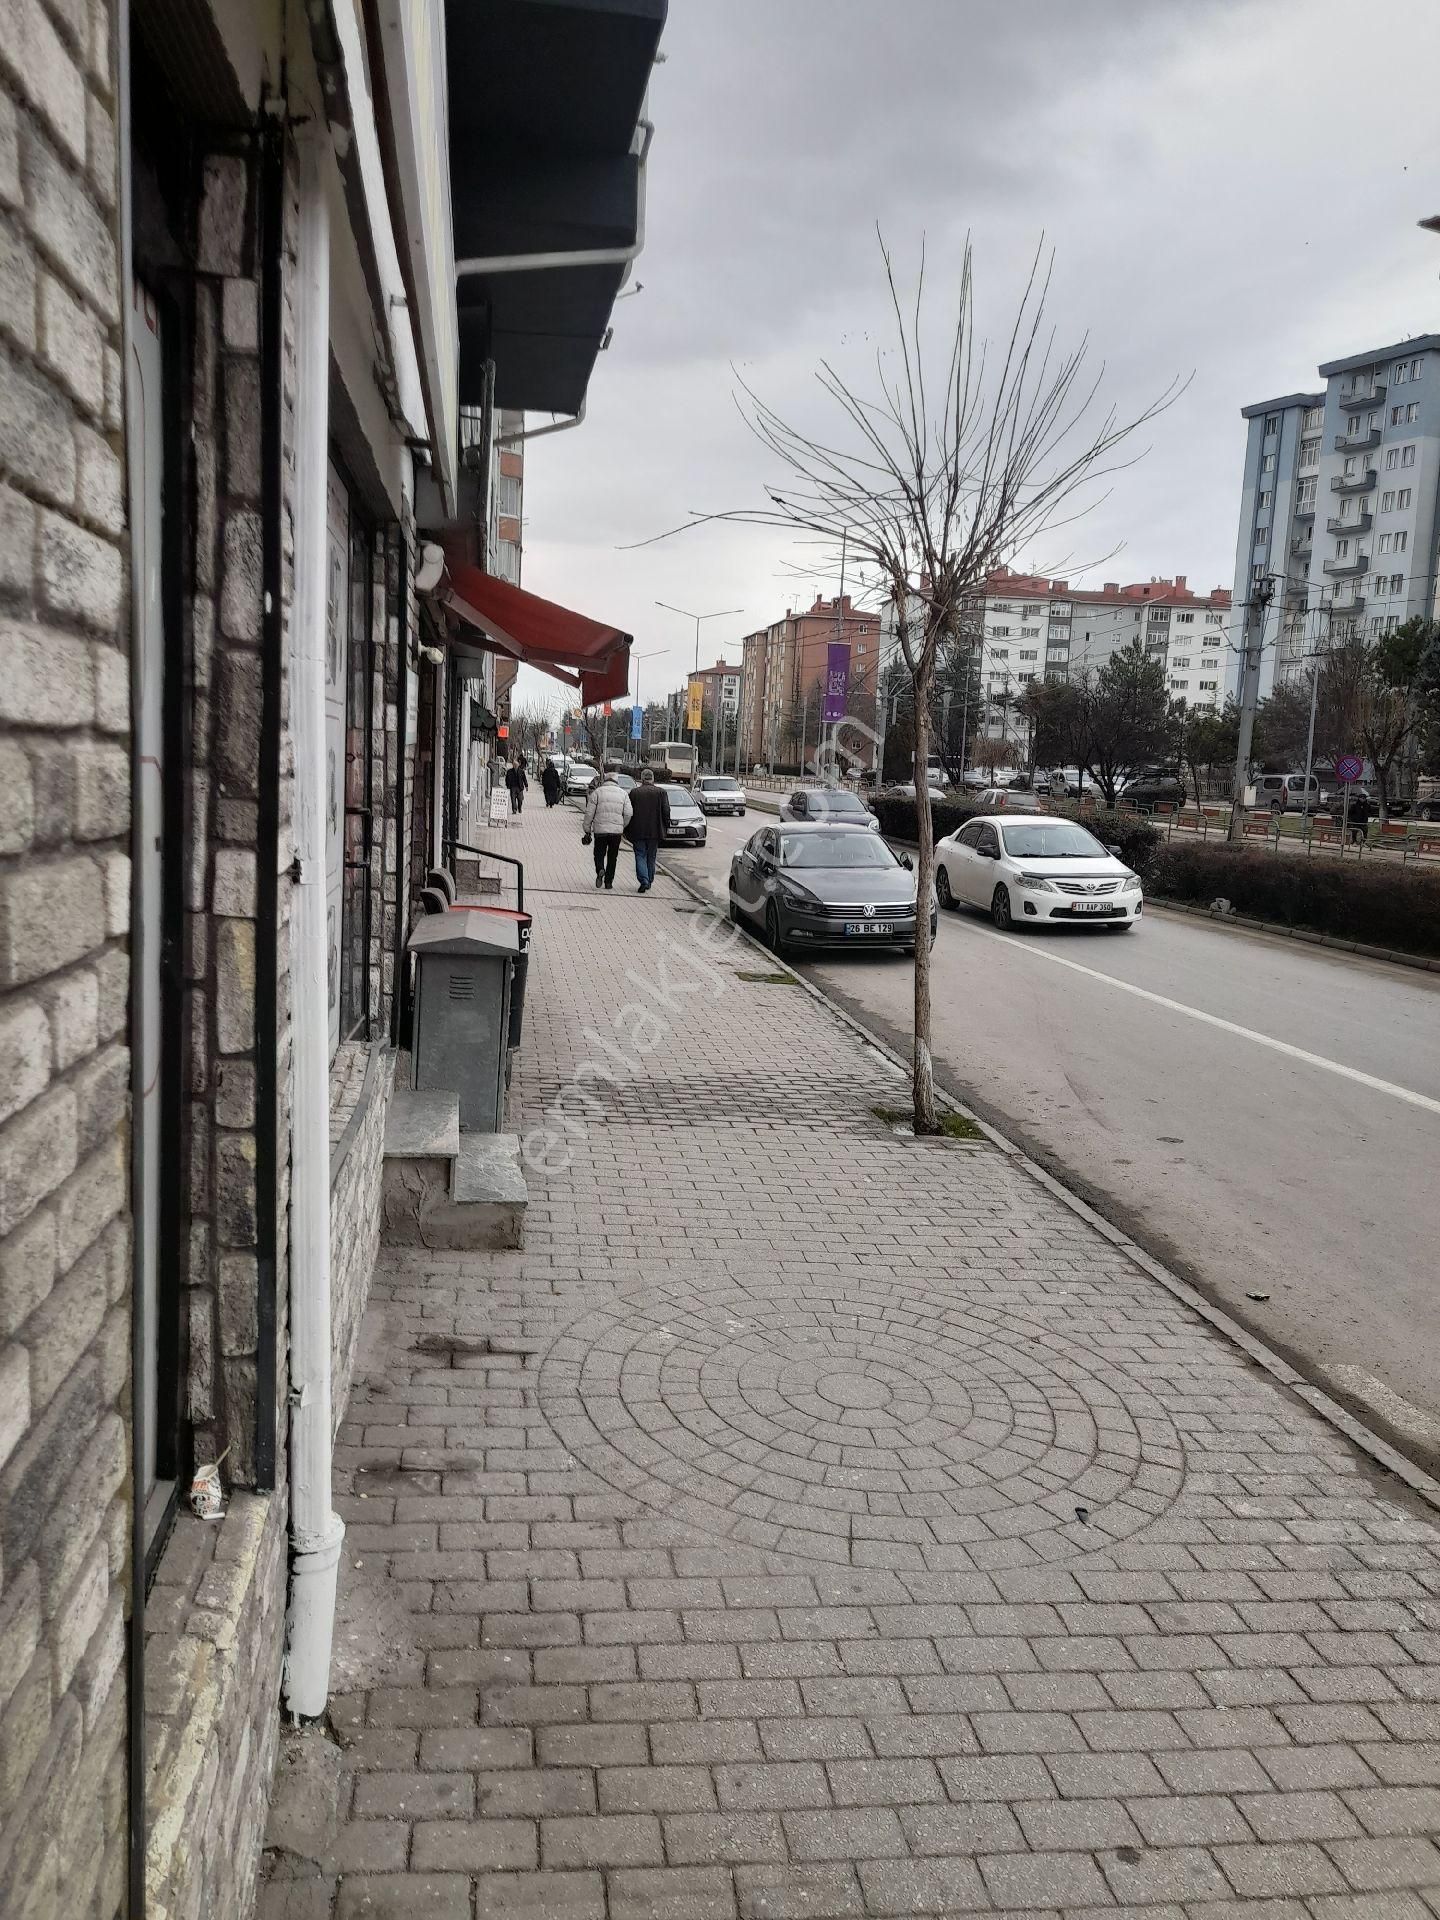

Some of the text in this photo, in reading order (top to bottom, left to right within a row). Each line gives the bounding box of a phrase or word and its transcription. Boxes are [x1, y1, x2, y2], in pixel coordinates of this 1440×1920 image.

[850, 924, 892, 933] 26 BE 129
